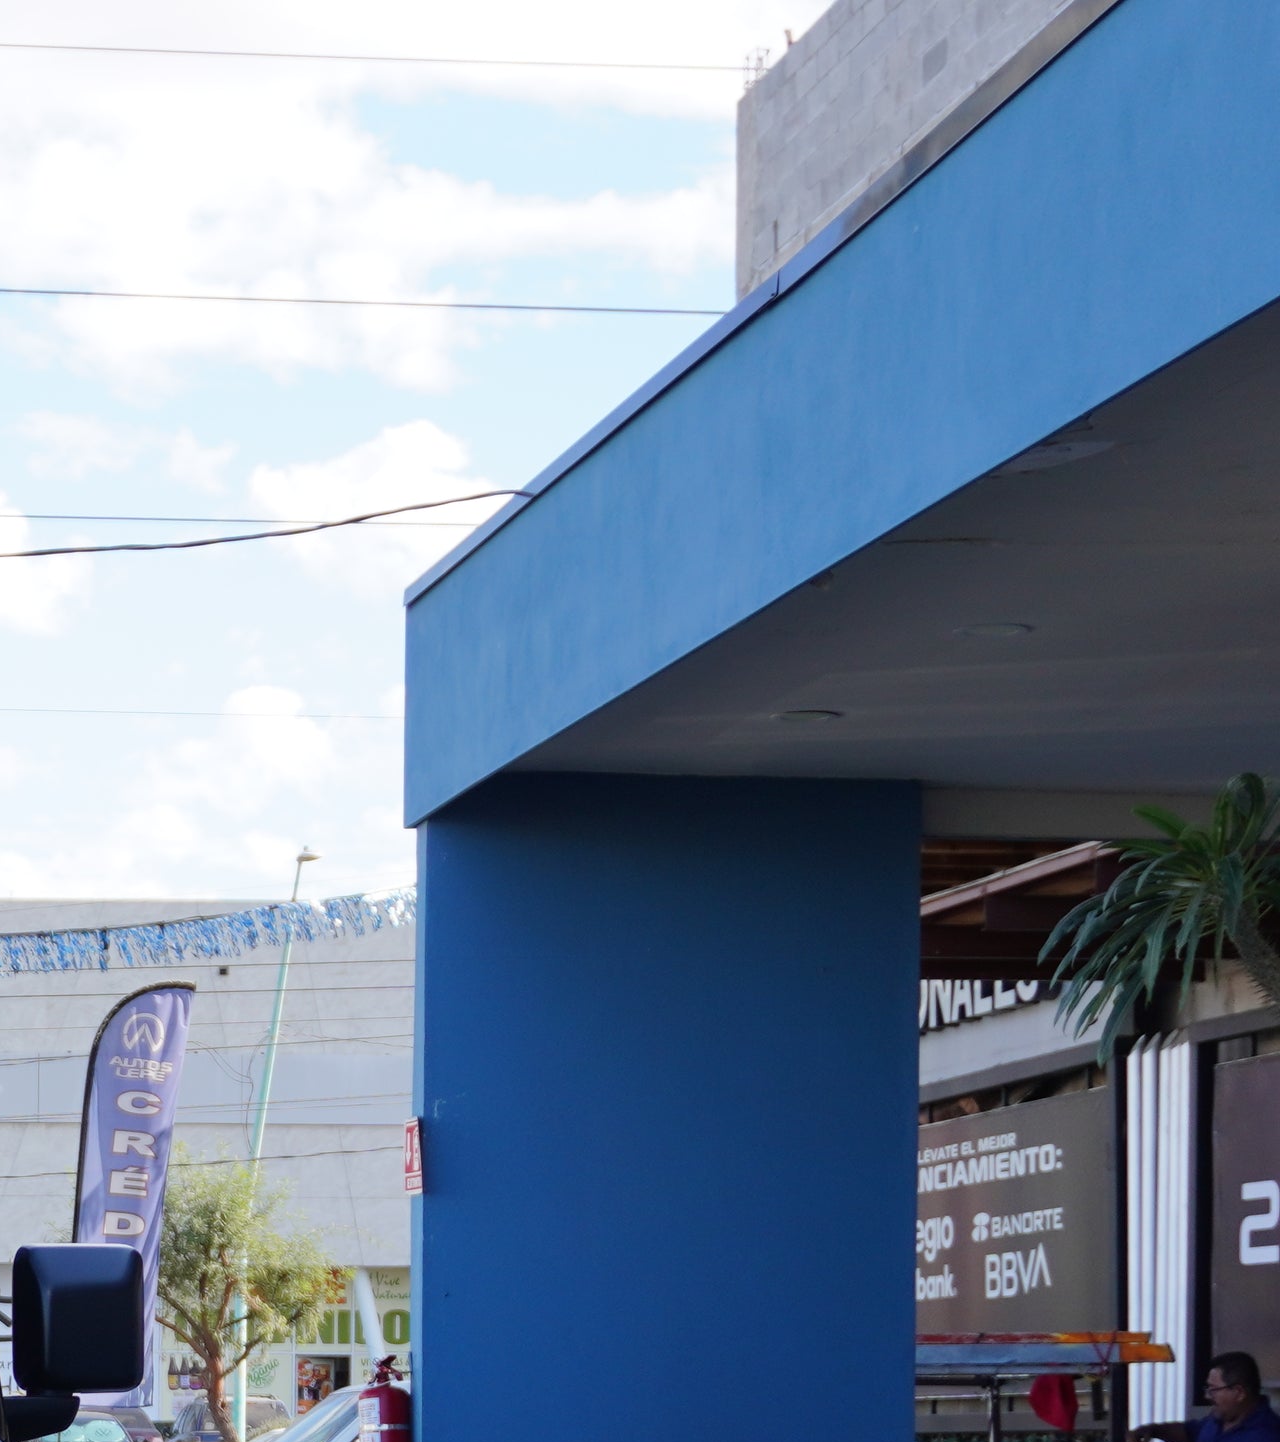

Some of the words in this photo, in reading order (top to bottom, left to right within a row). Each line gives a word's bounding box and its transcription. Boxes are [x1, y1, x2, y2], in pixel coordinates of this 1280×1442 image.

[109, 1056, 174, 1073] AUTOS
[116, 1067, 167, 1082] LEPE
[960, 1141, 976, 1154] EL
[978, 1132, 1017, 1152] MEJOR
[917, 1144, 1063, 1193] NCIAMIENTO:
[991, 1207, 1064, 1238] BANORTE
[985, 1242, 1052, 1299] BBVA
